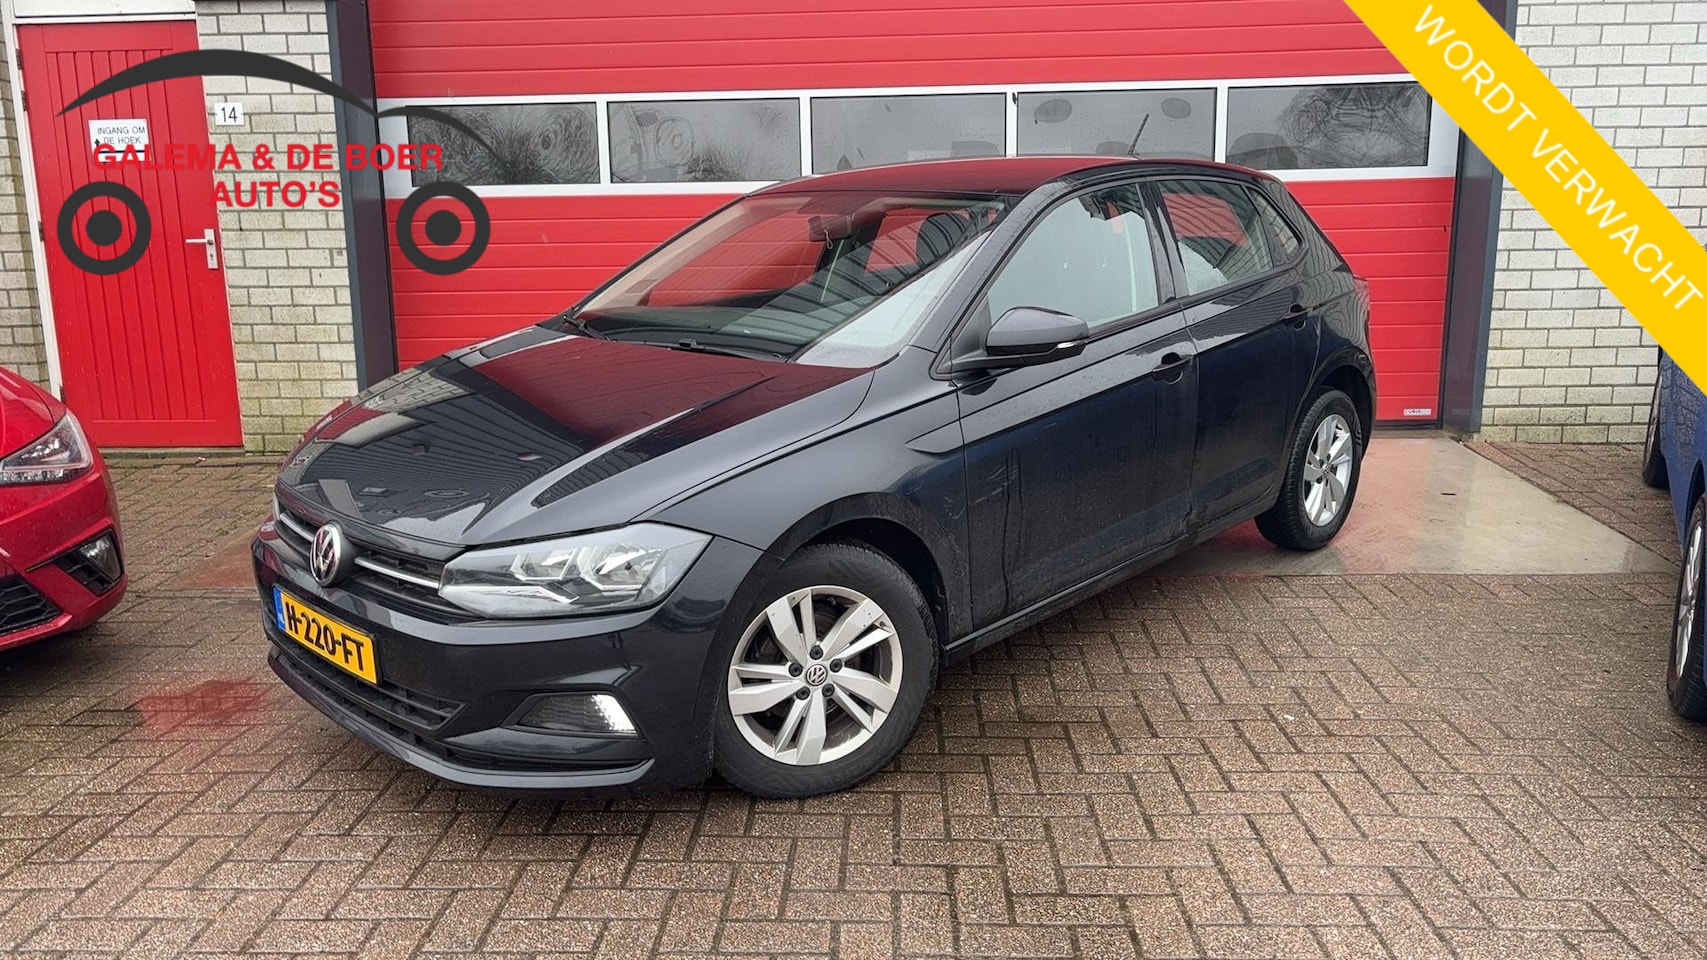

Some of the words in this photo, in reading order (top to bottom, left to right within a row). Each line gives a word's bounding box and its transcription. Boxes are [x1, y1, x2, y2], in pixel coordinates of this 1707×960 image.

[220, 106, 238, 123] 14
[97, 127, 129, 135] INGANG
[132, 126, 146, 134] OM
[118, 136, 142, 144] HOEK
[285, 601, 364, 672] H-220-FT
